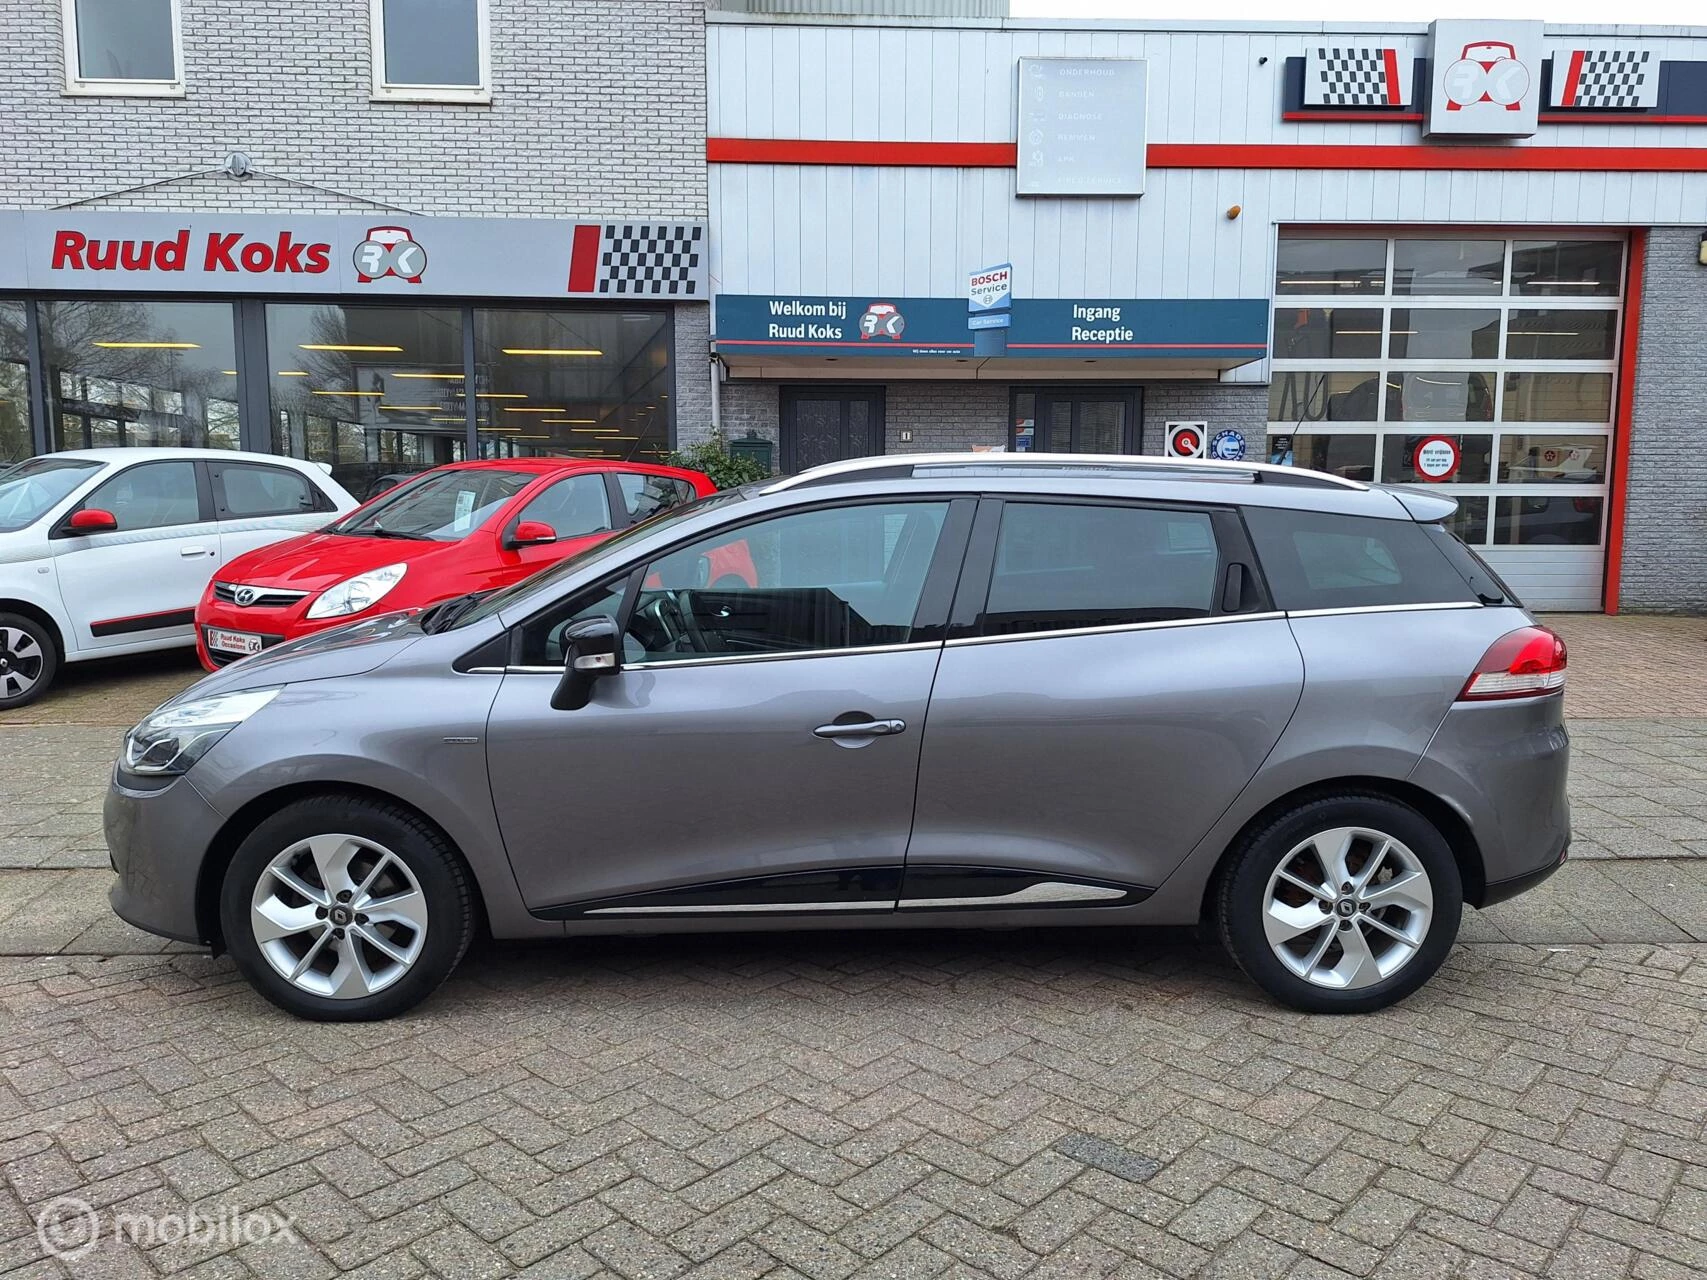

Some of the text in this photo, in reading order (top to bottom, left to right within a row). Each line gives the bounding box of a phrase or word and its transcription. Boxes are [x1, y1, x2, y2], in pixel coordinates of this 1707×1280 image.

[1059, 68, 1115, 77] ONDERHOUD
[51, 229, 191, 271] Ruud
[203, 231, 332, 273] Koks
[971, 270, 1008, 287] BOSCH
[970, 283, 1008, 296] Service
[769, 300, 847, 320] Welkom bij
[1073, 304, 1121, 322] Ingang
[768, 323, 843, 339] Ruud Koks
[1071, 326, 1134, 344] Receptie
[221, 633, 232, 641] Ruud
[221, 640, 246, 650] Occasions
